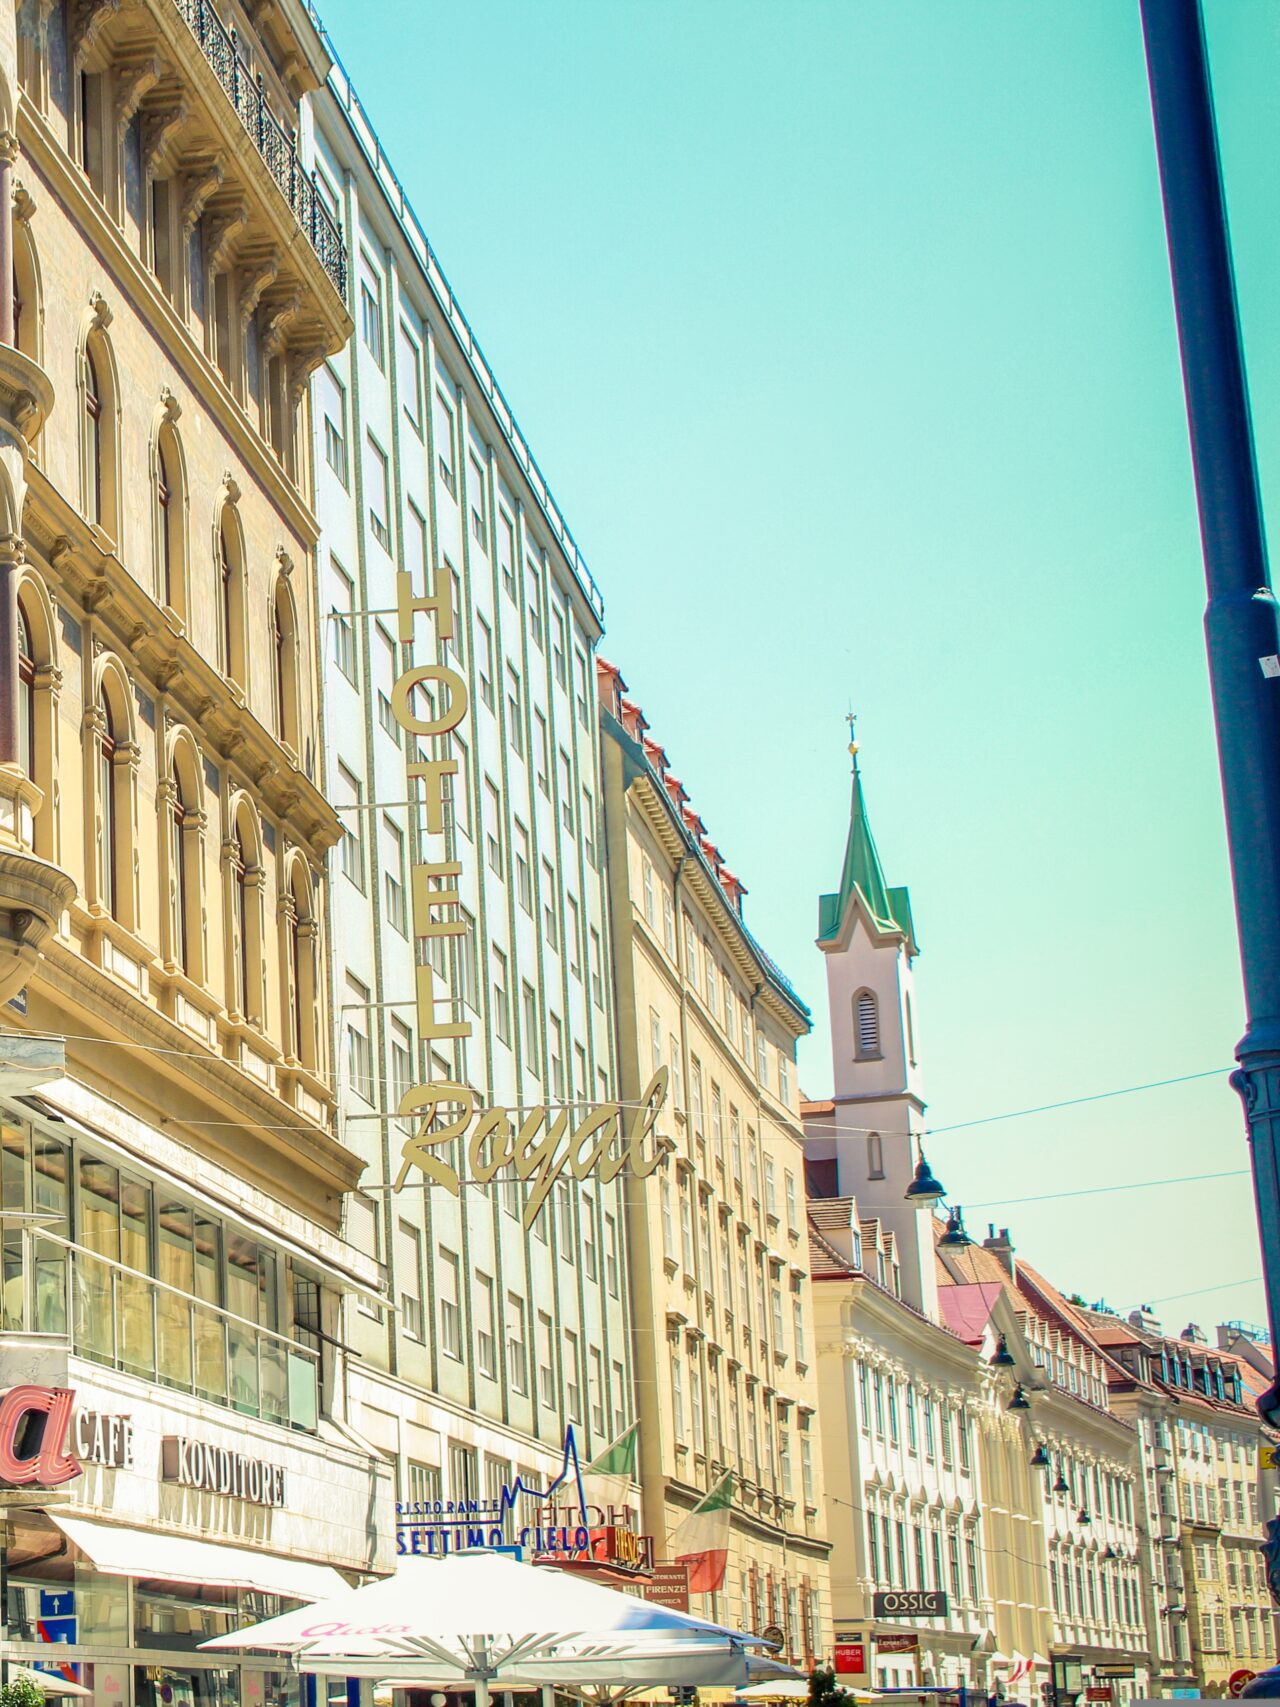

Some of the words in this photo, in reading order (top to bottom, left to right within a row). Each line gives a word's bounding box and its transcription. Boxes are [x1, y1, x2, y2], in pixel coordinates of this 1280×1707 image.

[390, 566, 473, 1041] HOTEL
[393, 1064, 671, 1230] Royal
[177, 1435, 288, 1507] KONDITOREI
[396, 1498, 500, 1515] RISTORANTE
[396, 1527, 503, 1556] SETTIMO
[521, 1526, 588, 1551] CIELO
[646, 1585, 687, 1594] FIRENZE
[883, 1593, 937, 1610] OSSIG
